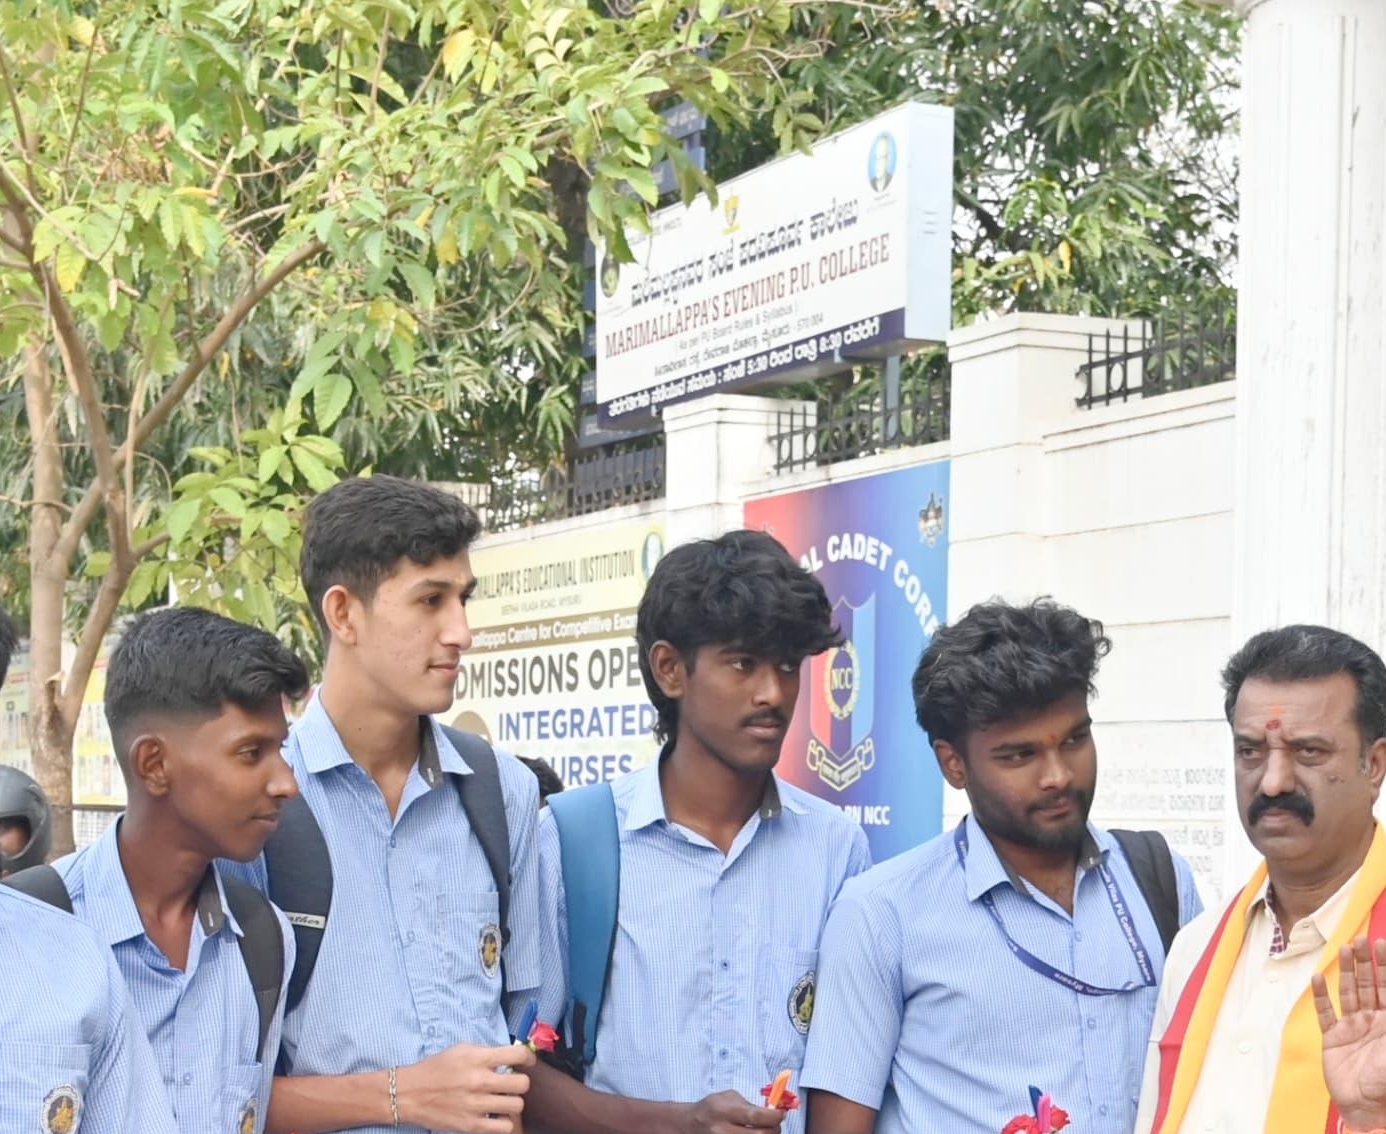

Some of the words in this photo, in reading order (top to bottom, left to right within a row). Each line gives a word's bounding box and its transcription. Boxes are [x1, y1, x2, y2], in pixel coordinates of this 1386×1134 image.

[605, 294, 719, 359] MARIMALLAPPA'S
[724, 271, 785, 317] EVENING
[790, 261, 815, 295] P.U.
[819, 232, 890, 285] COLLEGE
[476, 568, 521, 600] MALLAPPA'S
[523, 559, 578, 594] EDUCATIONAL
[579, 549, 635, 584] INSTITUTION
[826, 532, 894, 572] CADET
[893, 559, 940, 638] CORP
[472, 629, 506, 649] allappa
[508, 626, 537, 642] Centre
[539, 623, 552, 639] for
[552, 615, 612, 639] Competitive
[455, 650, 579, 700] DMISSIONS
[587, 644, 641, 691] OPE
[831, 667, 852, 690] NCC
[498, 703, 657, 741] INTEGRATED
[551, 754, 633, 786] URSES
[864, 804, 891, 825] NCC
